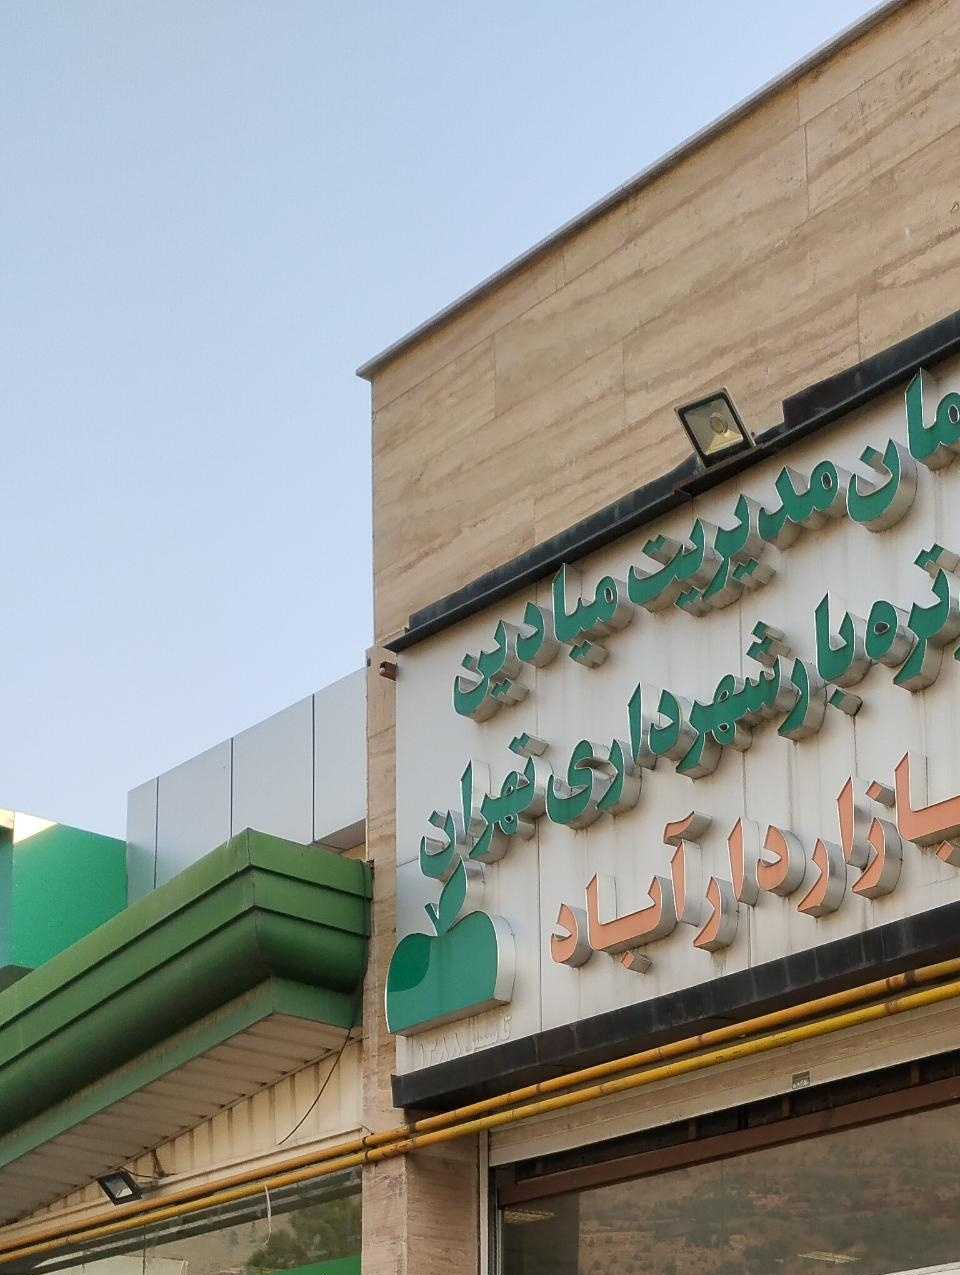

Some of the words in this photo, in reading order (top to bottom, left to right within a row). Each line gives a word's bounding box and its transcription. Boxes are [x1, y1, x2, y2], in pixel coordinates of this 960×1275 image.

[627, 460, 839, 609] مدیریت
[453, 563, 618, 721] میادین
[546, 621, 781, 824] شهرداری
[419, 732, 536, 880] تهران
